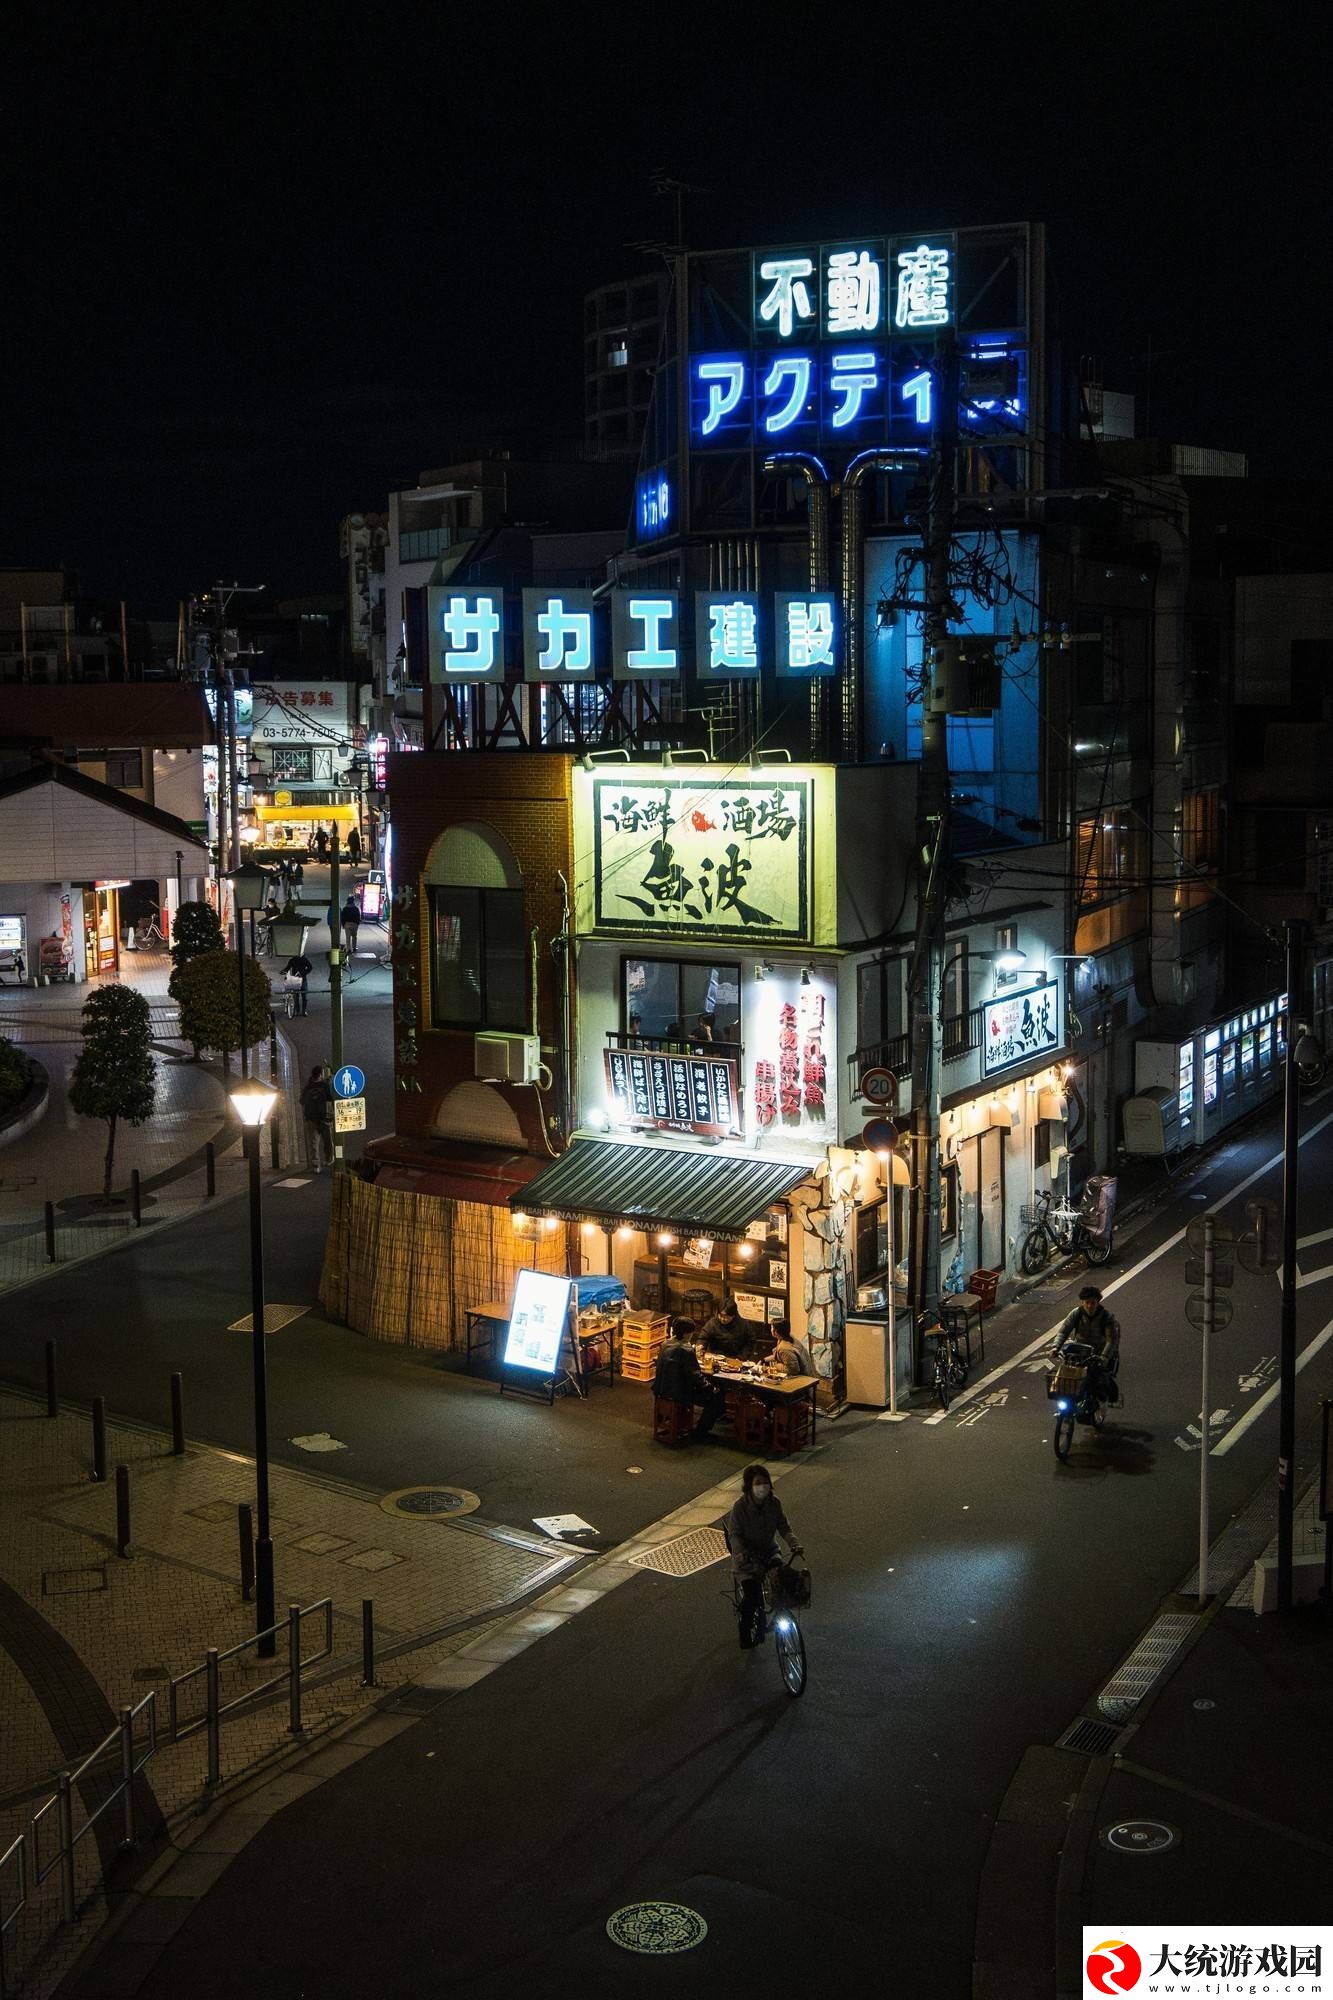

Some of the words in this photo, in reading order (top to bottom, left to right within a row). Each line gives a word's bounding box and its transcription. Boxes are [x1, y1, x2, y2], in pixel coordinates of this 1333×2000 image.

[760, 244, 950, 337] 不動産
[442, 596, 835, 673] サカエ建設
[604, 787, 676, 842] 海鮮
[720, 788, 797, 841] 酒場
[615, 839, 783, 926] 魚波
[754, 1060, 778, 1127] 串揚げ
[869, 1079, 889, 1094] 20
